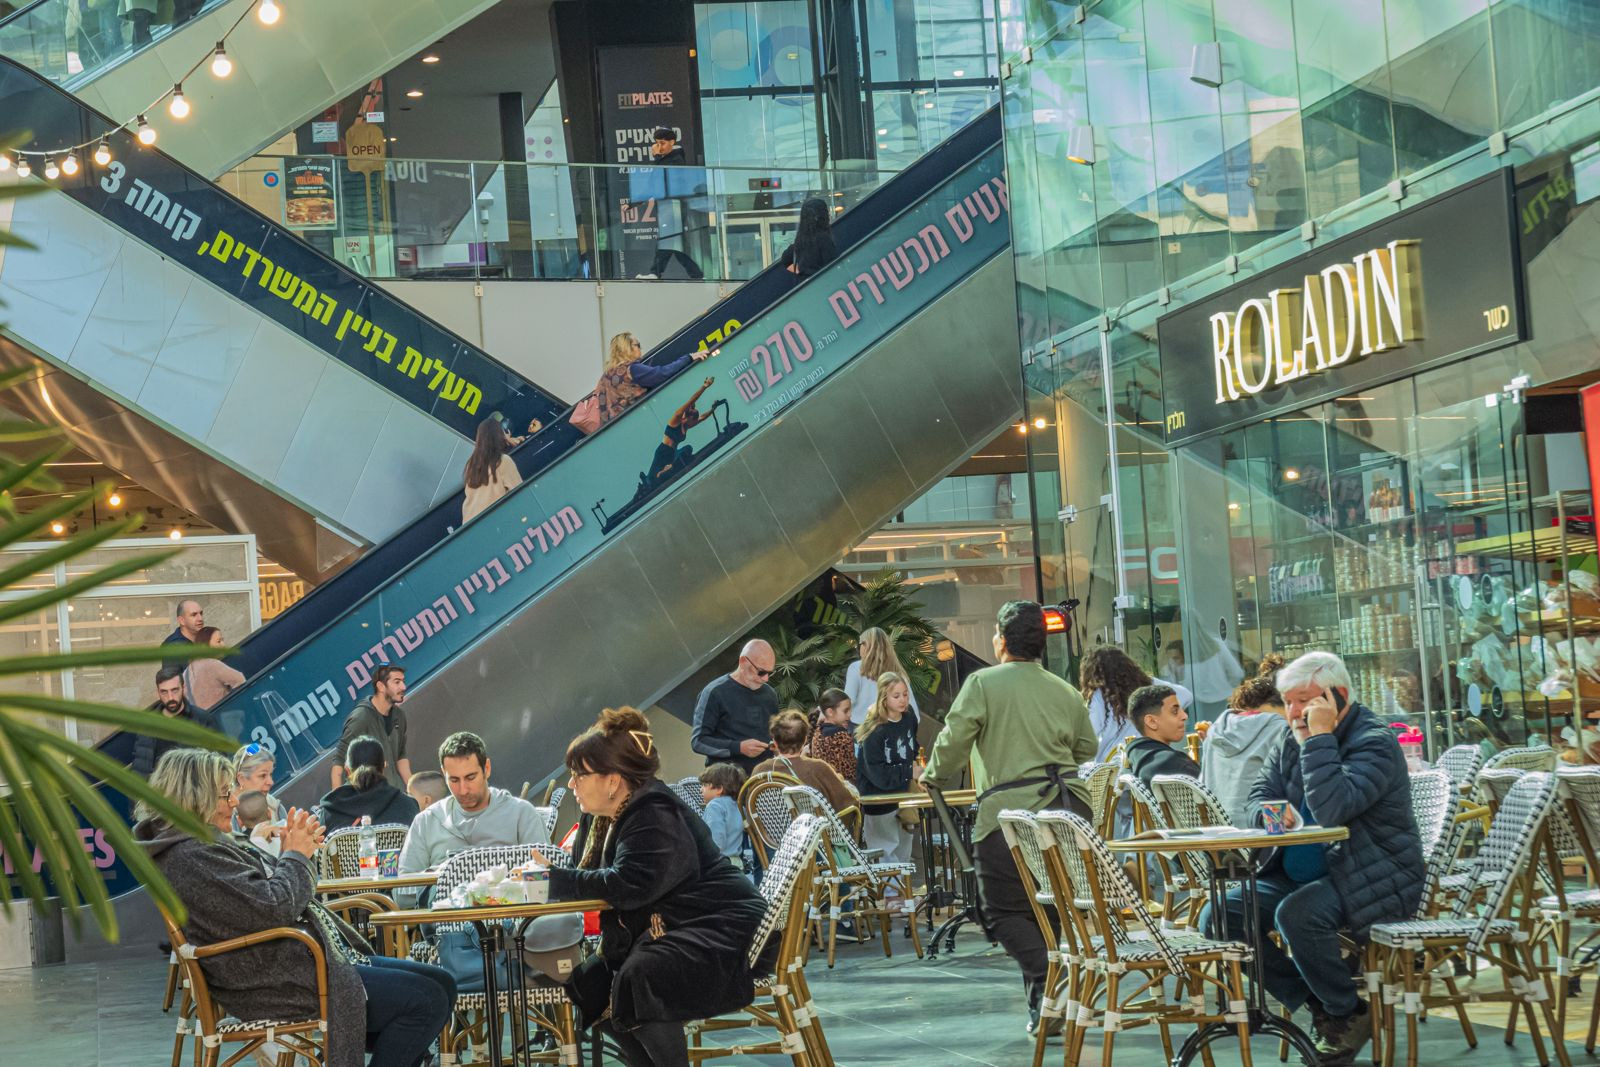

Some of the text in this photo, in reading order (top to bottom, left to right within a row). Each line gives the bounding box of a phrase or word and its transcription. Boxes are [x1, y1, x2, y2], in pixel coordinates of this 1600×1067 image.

[618, 92, 673, 106] FITPILATES
[351, 145, 381, 156] OPEN
[616, 126, 682, 145] פאטיס
[101, 160, 483, 416] מעלית בניין המשרדים, קומה 3
[828, 224, 951, 329] מכשירים
[1210, 239, 1417, 404] ROLADIN
[1483, 305, 1510, 332] כשר
[505, 505, 585, 573] מעלית
[456, 559, 512, 615] בניין
[345, 595, 458, 701] המשרדים,
[272, 679, 341, 744] קומה
